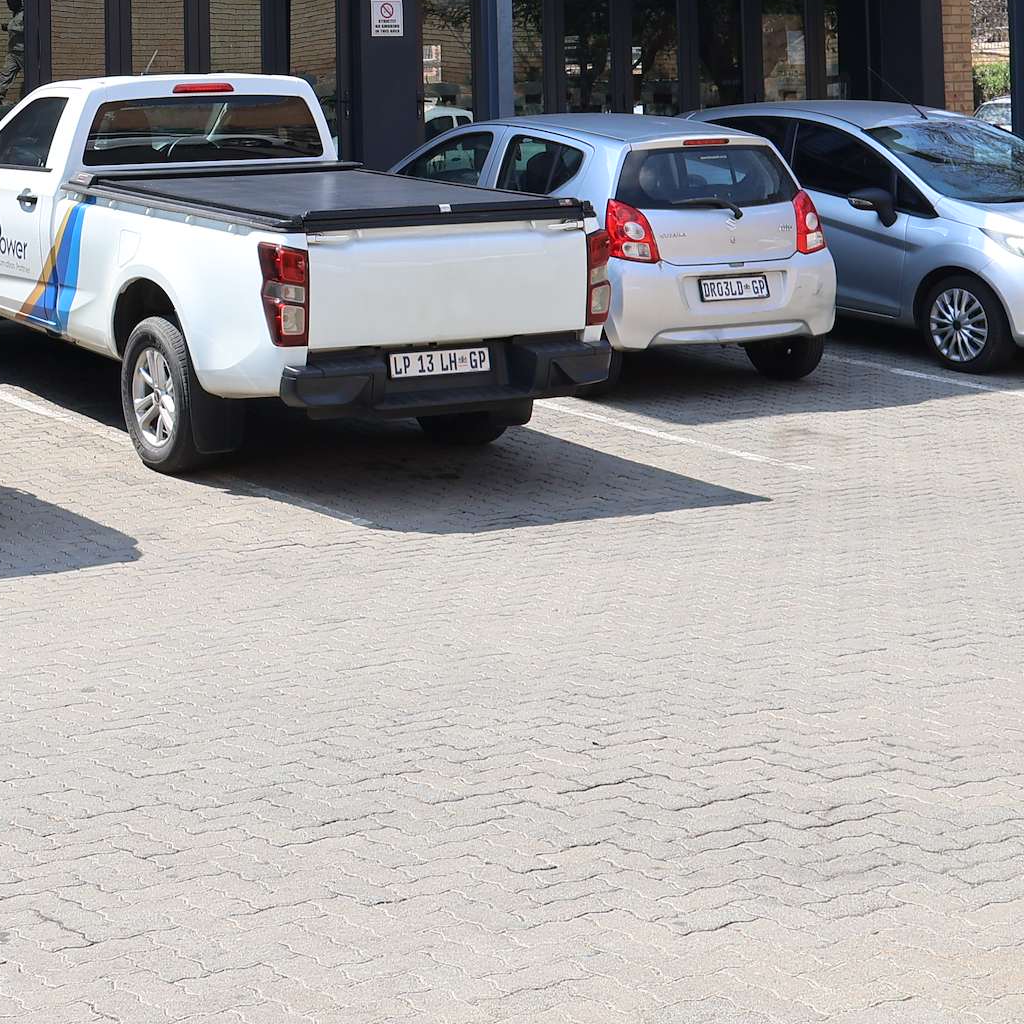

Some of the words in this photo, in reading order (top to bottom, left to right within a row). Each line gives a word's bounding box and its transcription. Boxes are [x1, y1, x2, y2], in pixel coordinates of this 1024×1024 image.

[752, 280, 764, 295] GP
[394, 355, 410, 375] LP
[417, 354, 434, 373] 13
[440, 352, 457, 371] LH
[469, 351, 485, 369] GP
